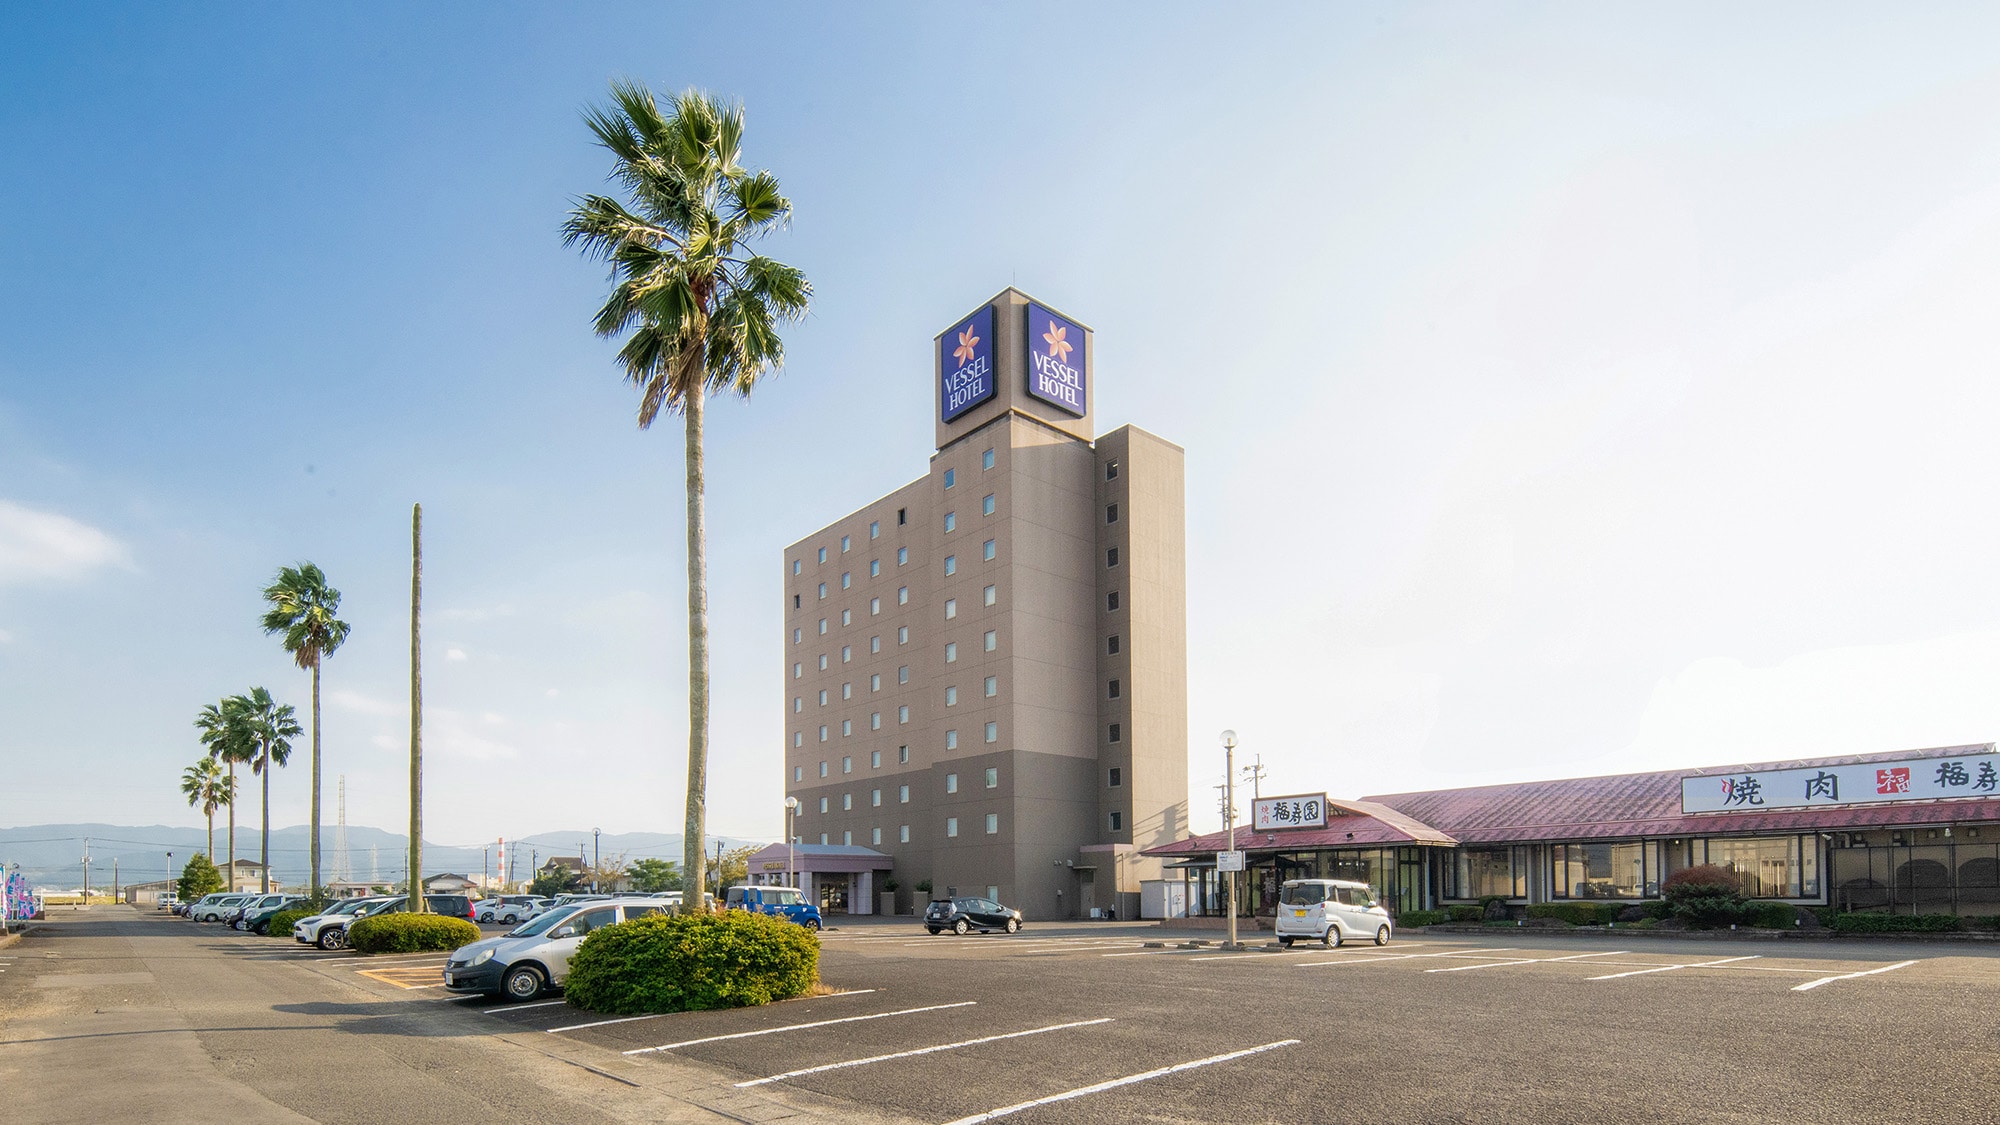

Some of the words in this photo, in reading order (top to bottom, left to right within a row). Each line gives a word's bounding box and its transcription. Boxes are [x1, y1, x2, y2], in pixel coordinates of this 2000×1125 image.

[945, 356, 989, 394] VESSEL
[1033, 351, 1082, 391] VESSEL
[949, 379, 986, 411] HOTEL
[1038, 373, 1080, 407] HOTEL
[1721, 771, 1839, 806] 焼肉
[1934, 761, 1999, 792] 福寿
[1272, 800, 1319, 825] 福寿園
